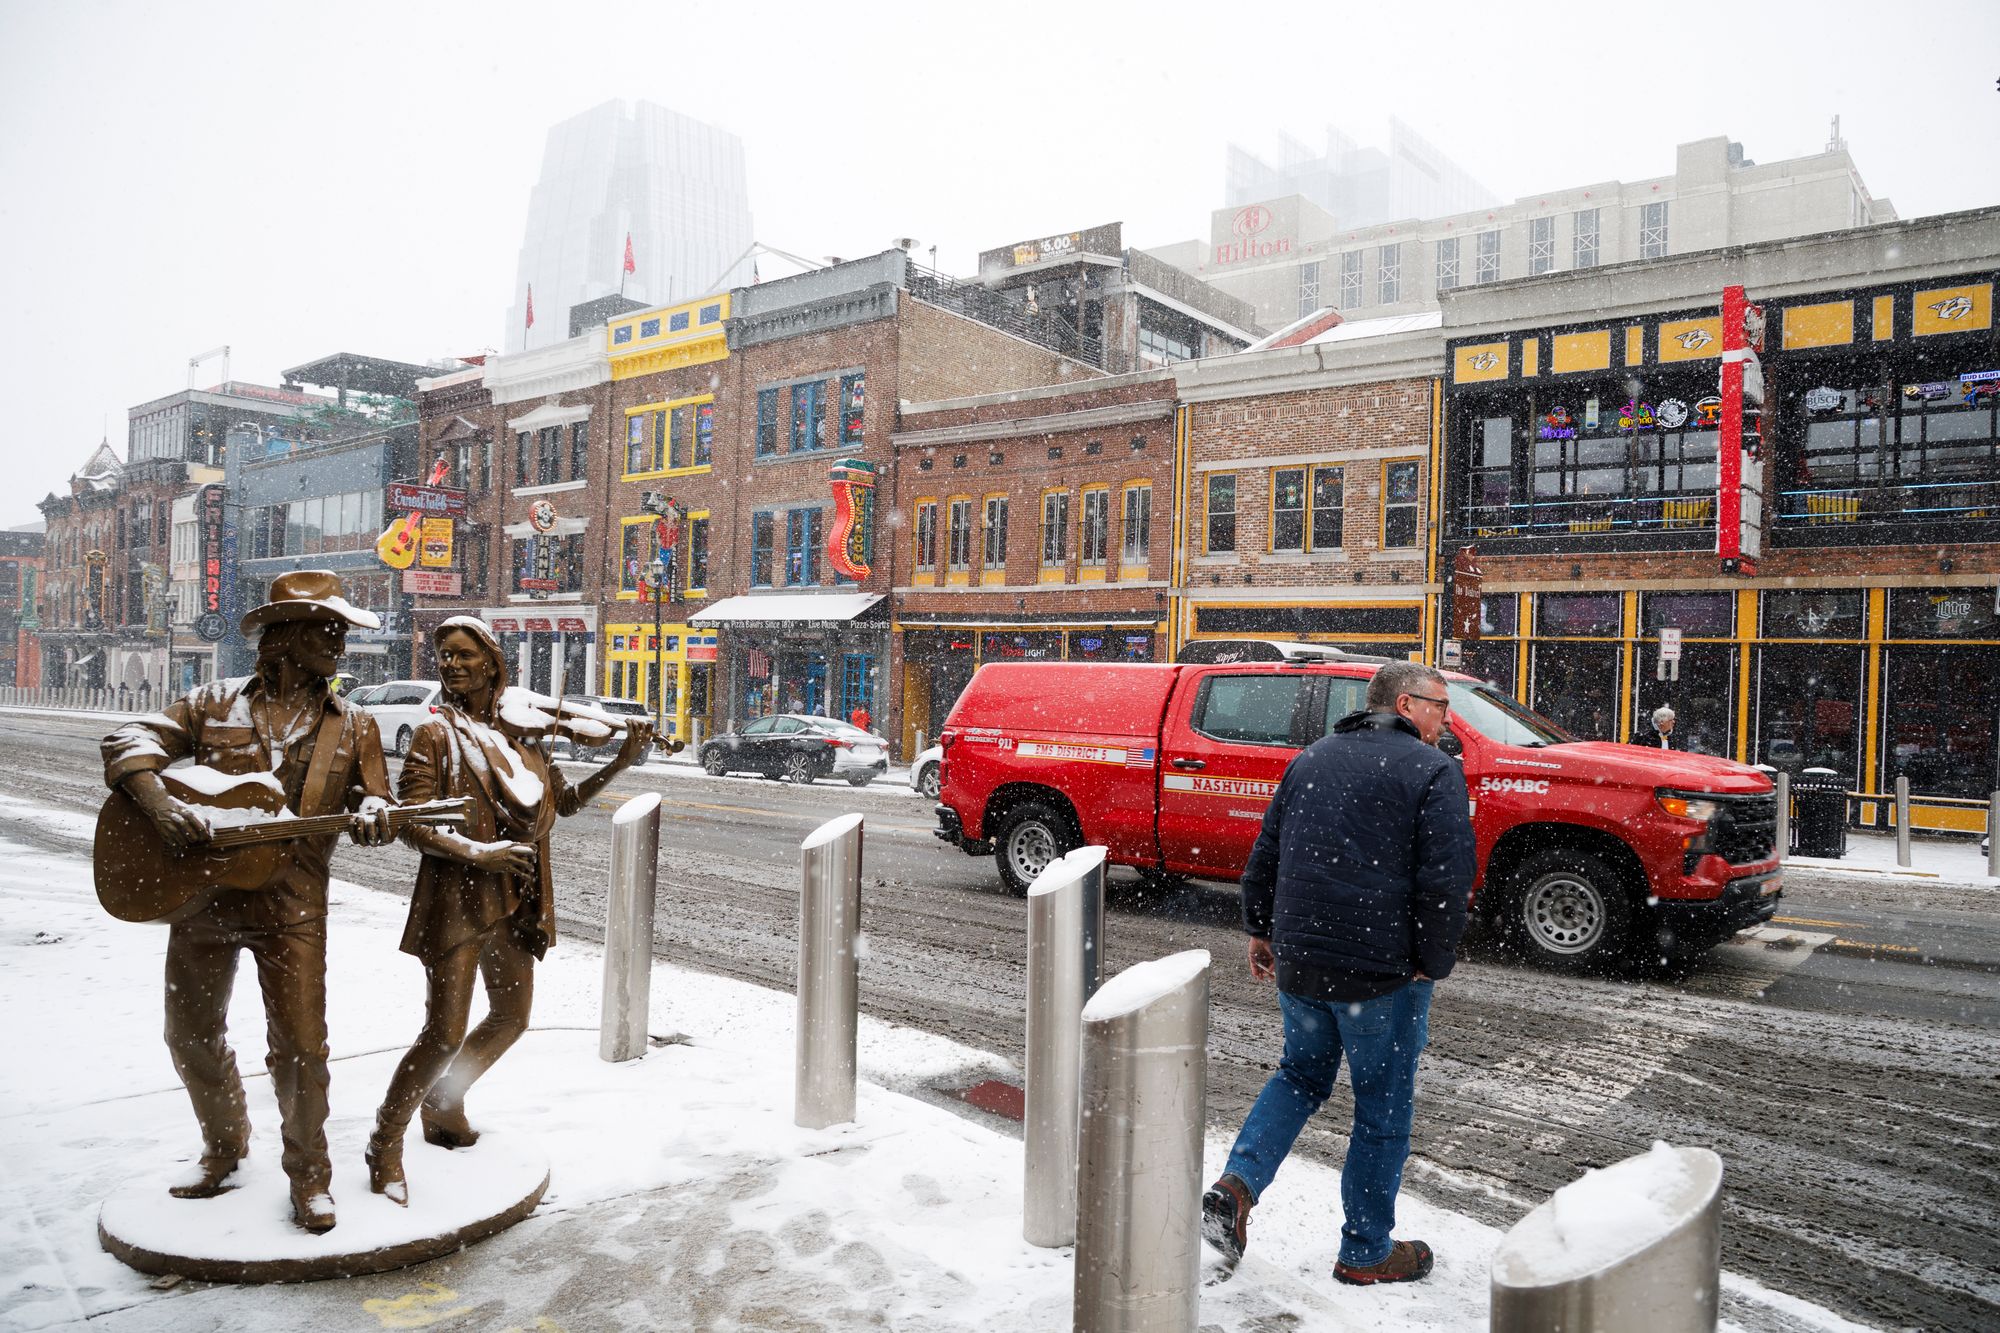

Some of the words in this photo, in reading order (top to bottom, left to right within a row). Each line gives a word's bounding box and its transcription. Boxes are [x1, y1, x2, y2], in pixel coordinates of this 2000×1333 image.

[1217, 238, 1290, 265] Hilton
[1979, 372, 2000, 380] LIGHT
[1806, 395, 1840, 406] BUSCH
[394, 488, 423, 508] Ernest
[417, 491, 447, 510] Tubb
[853, 487, 865, 562] MUSHROOM
[205, 489, 222, 611] FRIENDS
[538, 535, 550, 579] HANK
[1937, 601, 1971, 618] Lite
[692, 620, 711, 629] Rooftop
[712, 620, 720, 628] Bar
[731, 620, 745, 628] Pizza
[765, 620, 780, 628] Since
[808, 620, 821, 629] Live
[821, 620, 839, 630] Music
[850, 620, 866, 629] Pizza
[1025, 649, 1046, 657] LIGHT
[1215, 649, 1244, 664] Rippy's
[998, 738, 1013, 749] 911
[1035, 745, 1054, 756] EMS
[1057, 746, 1098, 760] DISTRICT
[1101, 749, 1107, 760] 5
[1495, 758, 1562, 769] SILVERADO
[1193, 779, 1275, 796] NASHVILLE
[1480, 776, 1550, 795] 5694BC
